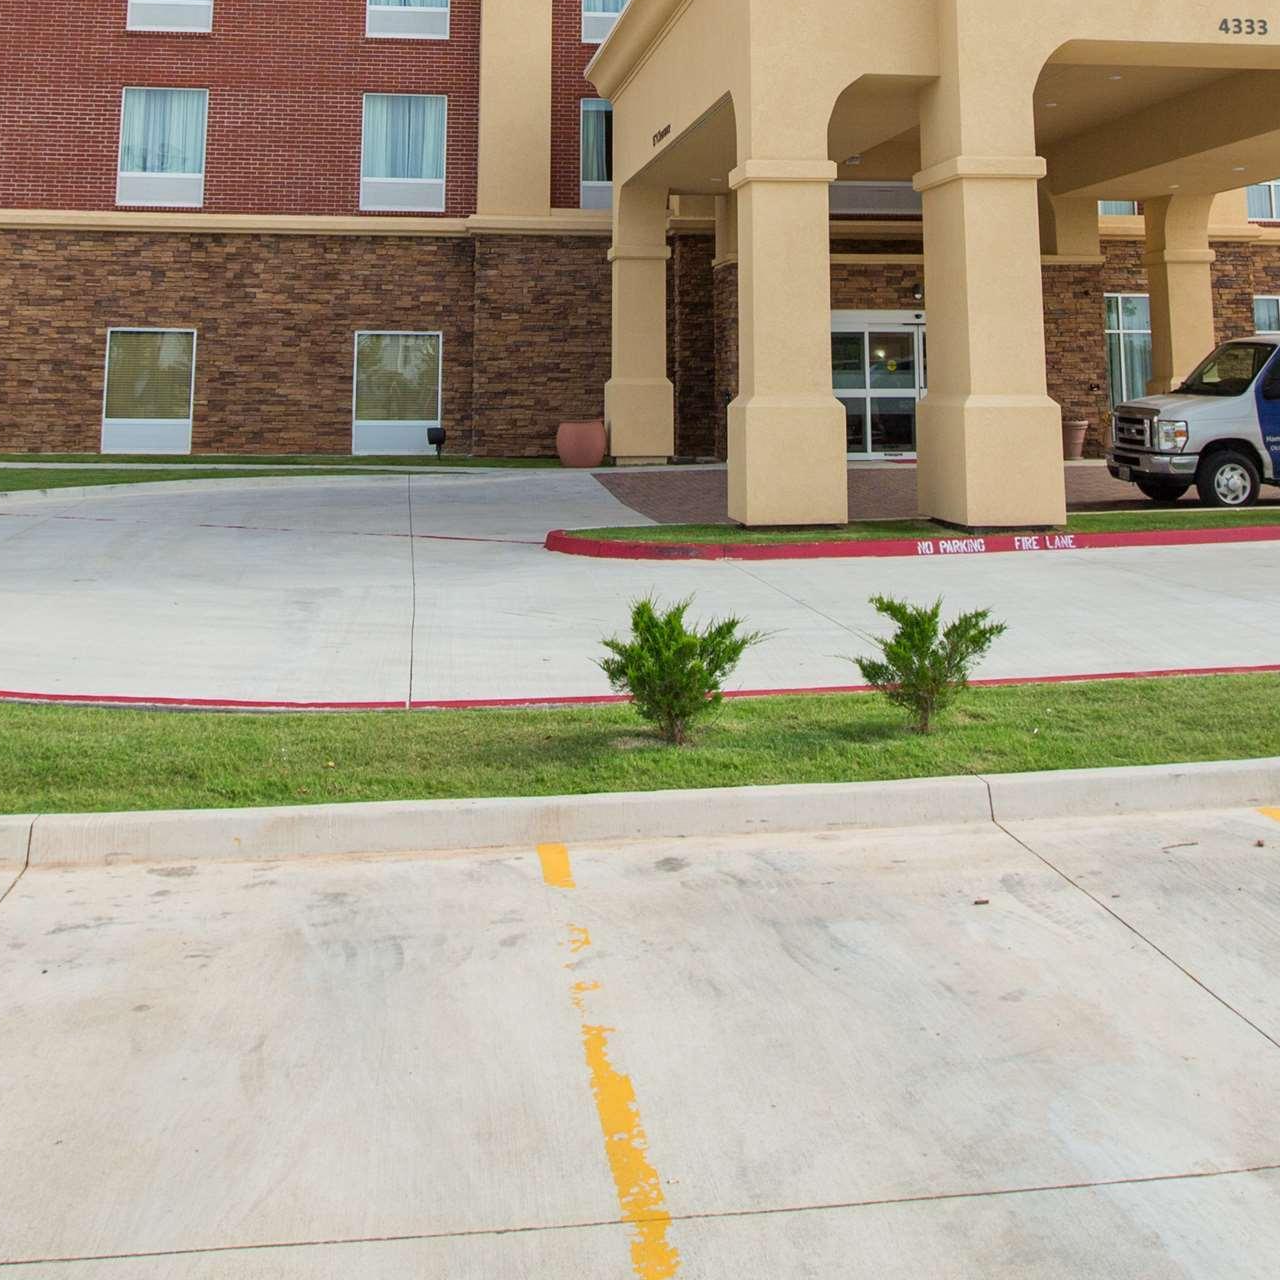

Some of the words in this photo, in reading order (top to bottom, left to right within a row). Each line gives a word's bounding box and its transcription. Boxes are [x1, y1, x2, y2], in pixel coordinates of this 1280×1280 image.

[1218, 18, 1268, 35] 4333
[917, 541, 934, 555] NO
[939, 538, 986, 554] PARKING
[1014, 535, 1040, 551] FIRE
[1045, 535, 1077, 550] LANE
